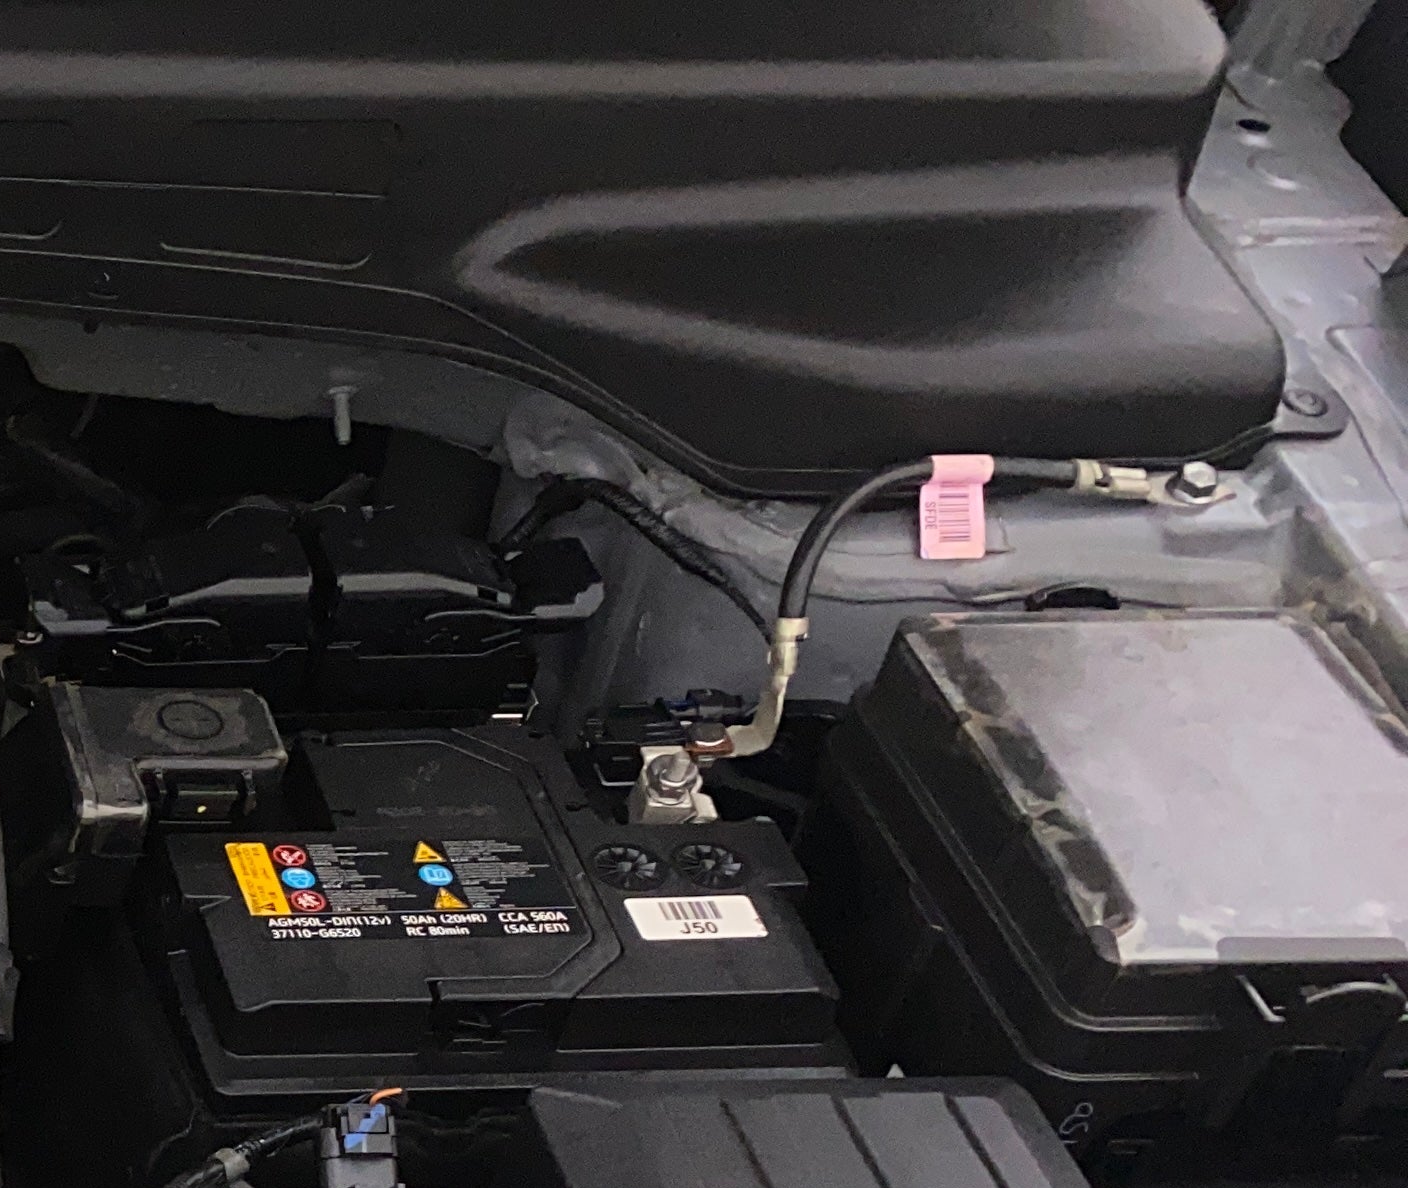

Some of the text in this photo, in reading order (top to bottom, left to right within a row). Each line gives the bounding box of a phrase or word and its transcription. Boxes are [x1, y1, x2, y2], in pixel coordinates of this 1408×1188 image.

[400, 915, 437, 925] 50Ah
[440, 914, 488, 924] (20HR)
[498, 912, 528, 923] CCA
[529, 912, 568, 921] 560A
[271, 927, 362, 940] 37110-G6520
[406, 926, 427, 937] RC
[428, 926, 470, 936] 80min
[680, 921, 718, 934] J50
